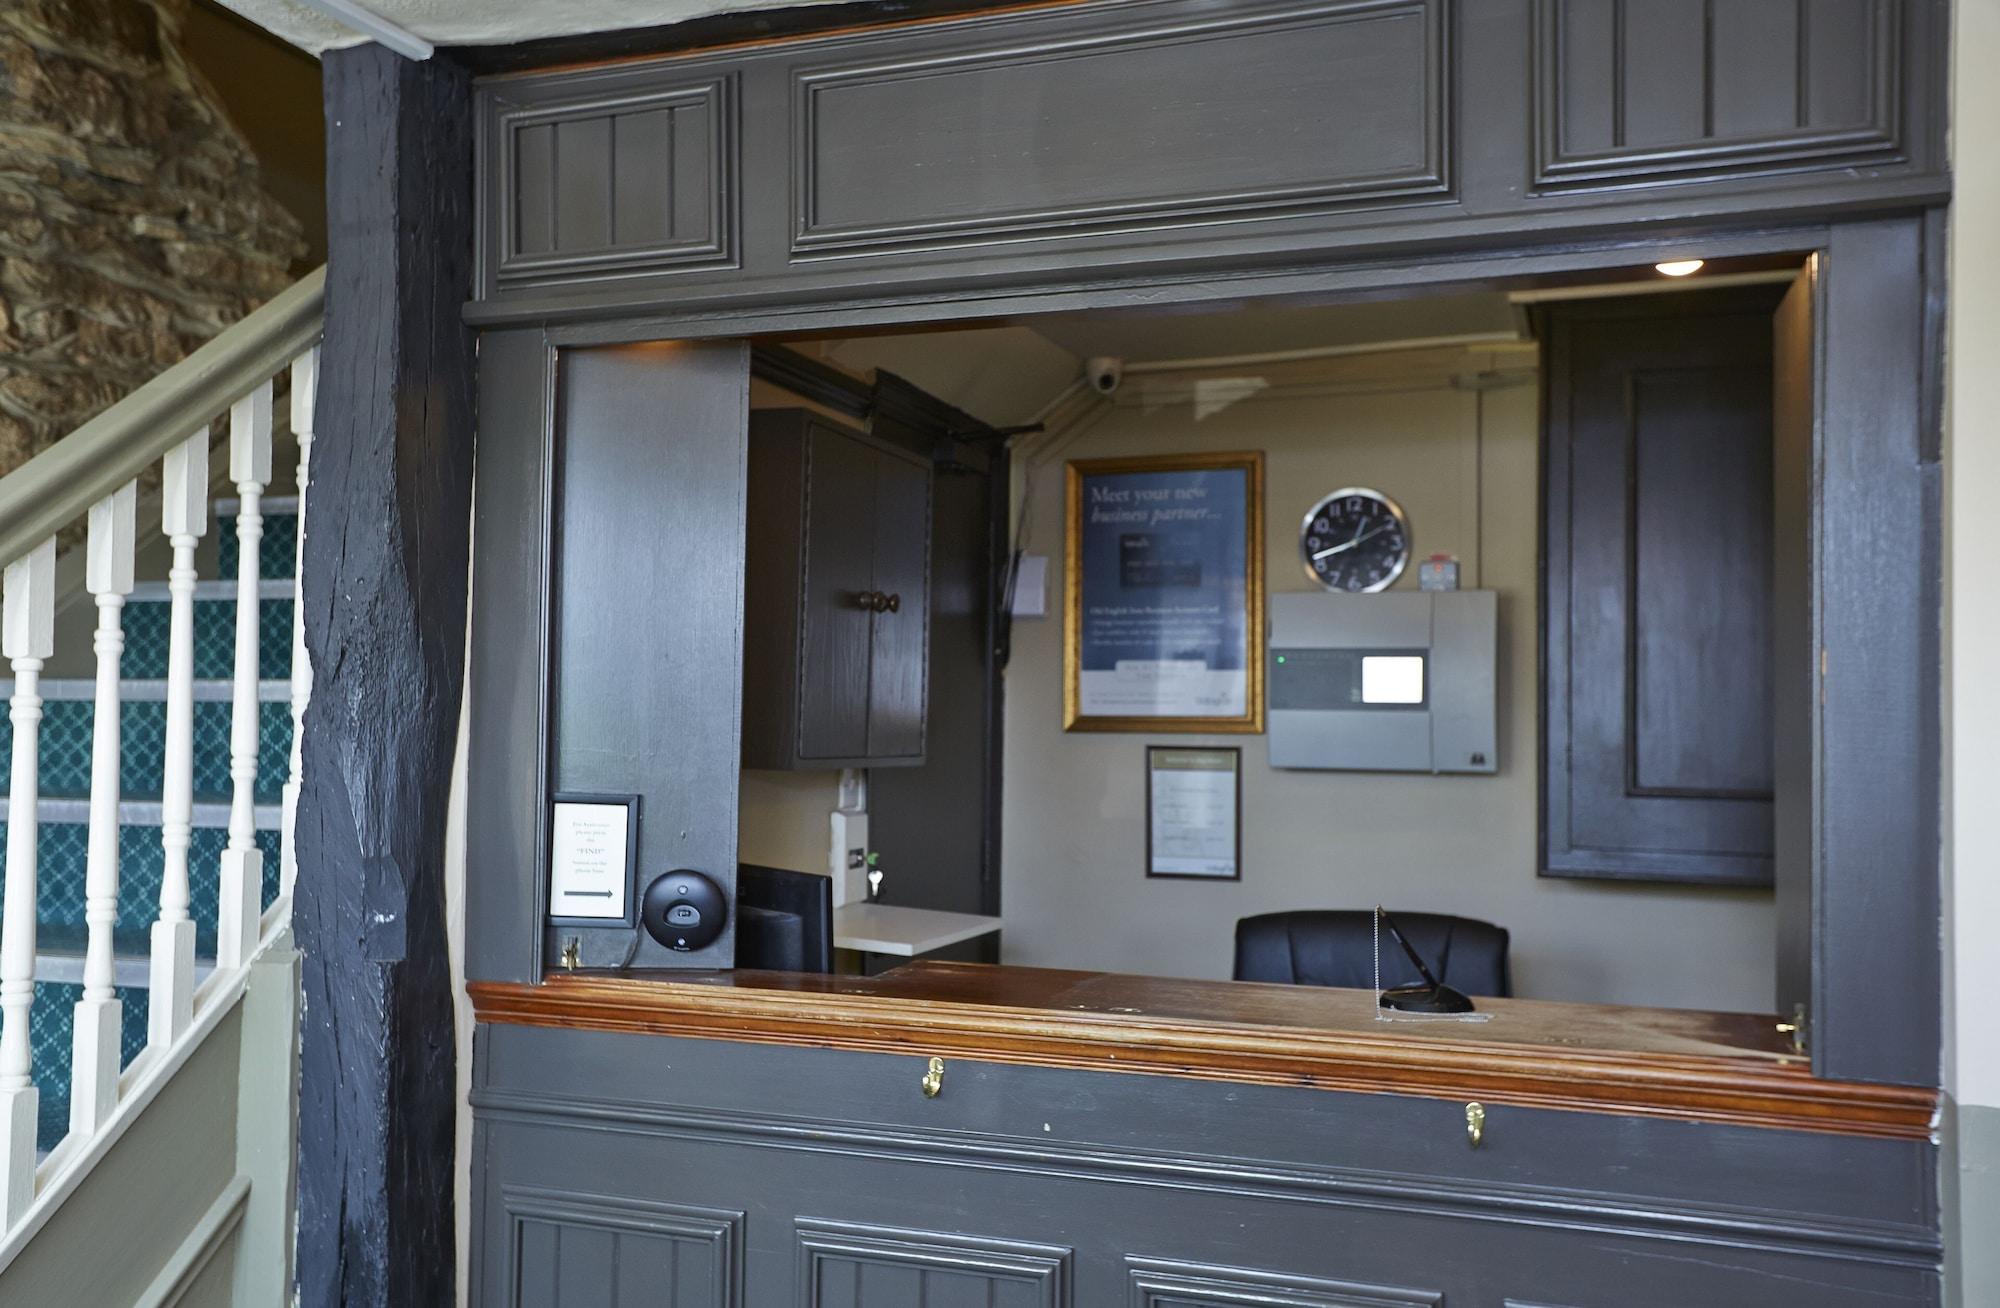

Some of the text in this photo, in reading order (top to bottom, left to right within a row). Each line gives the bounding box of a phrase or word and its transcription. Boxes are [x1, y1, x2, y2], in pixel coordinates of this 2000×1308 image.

[1091, 486, 1207, 505] Meet your new
[1329, 503, 1341, 516] 11
[1345, 497, 1362, 512] 12
[1372, 503, 1378, 515] 1
[1091, 506, 1148, 523] business
[1313, 517, 1329, 534] 10
[1384, 516, 1396, 529] 2
[1308, 537, 1320, 552] 9
[1390, 535, 1403, 550] 3
[1315, 559, 1327, 572] 8
[1383, 556, 1395, 568] 4
[1329, 571, 1341, 585] 7
[1347, 576, 1362, 590] 6
[1369, 570, 1380, 582] 5
